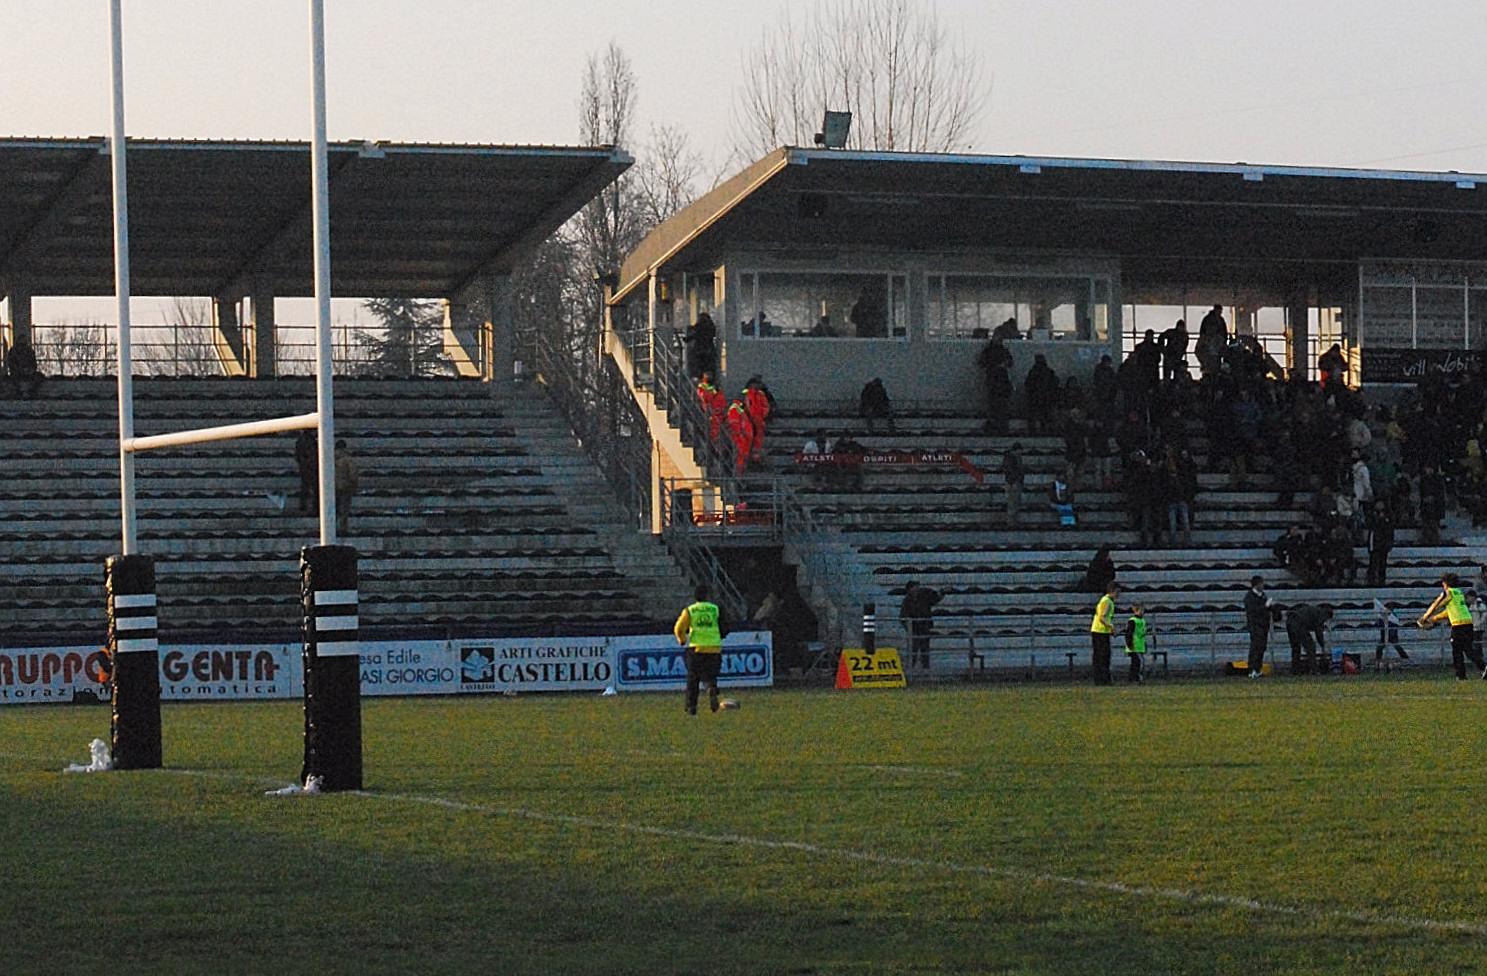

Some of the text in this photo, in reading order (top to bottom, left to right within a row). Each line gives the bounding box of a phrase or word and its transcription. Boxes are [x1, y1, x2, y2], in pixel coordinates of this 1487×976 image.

[387, 649, 421, 664] Edile
[499, 645, 608, 660] ARTI GRAFICHE
[163, 650, 280, 682] GENTA
[627, 652, 765, 677] S.MAINO
[849, 656, 898, 671] 22 mt
[359, 666, 455, 685] ASI GIORGIO
[498, 661, 612, 684] CASTELLO
[160, 684, 277, 695] tomatica
